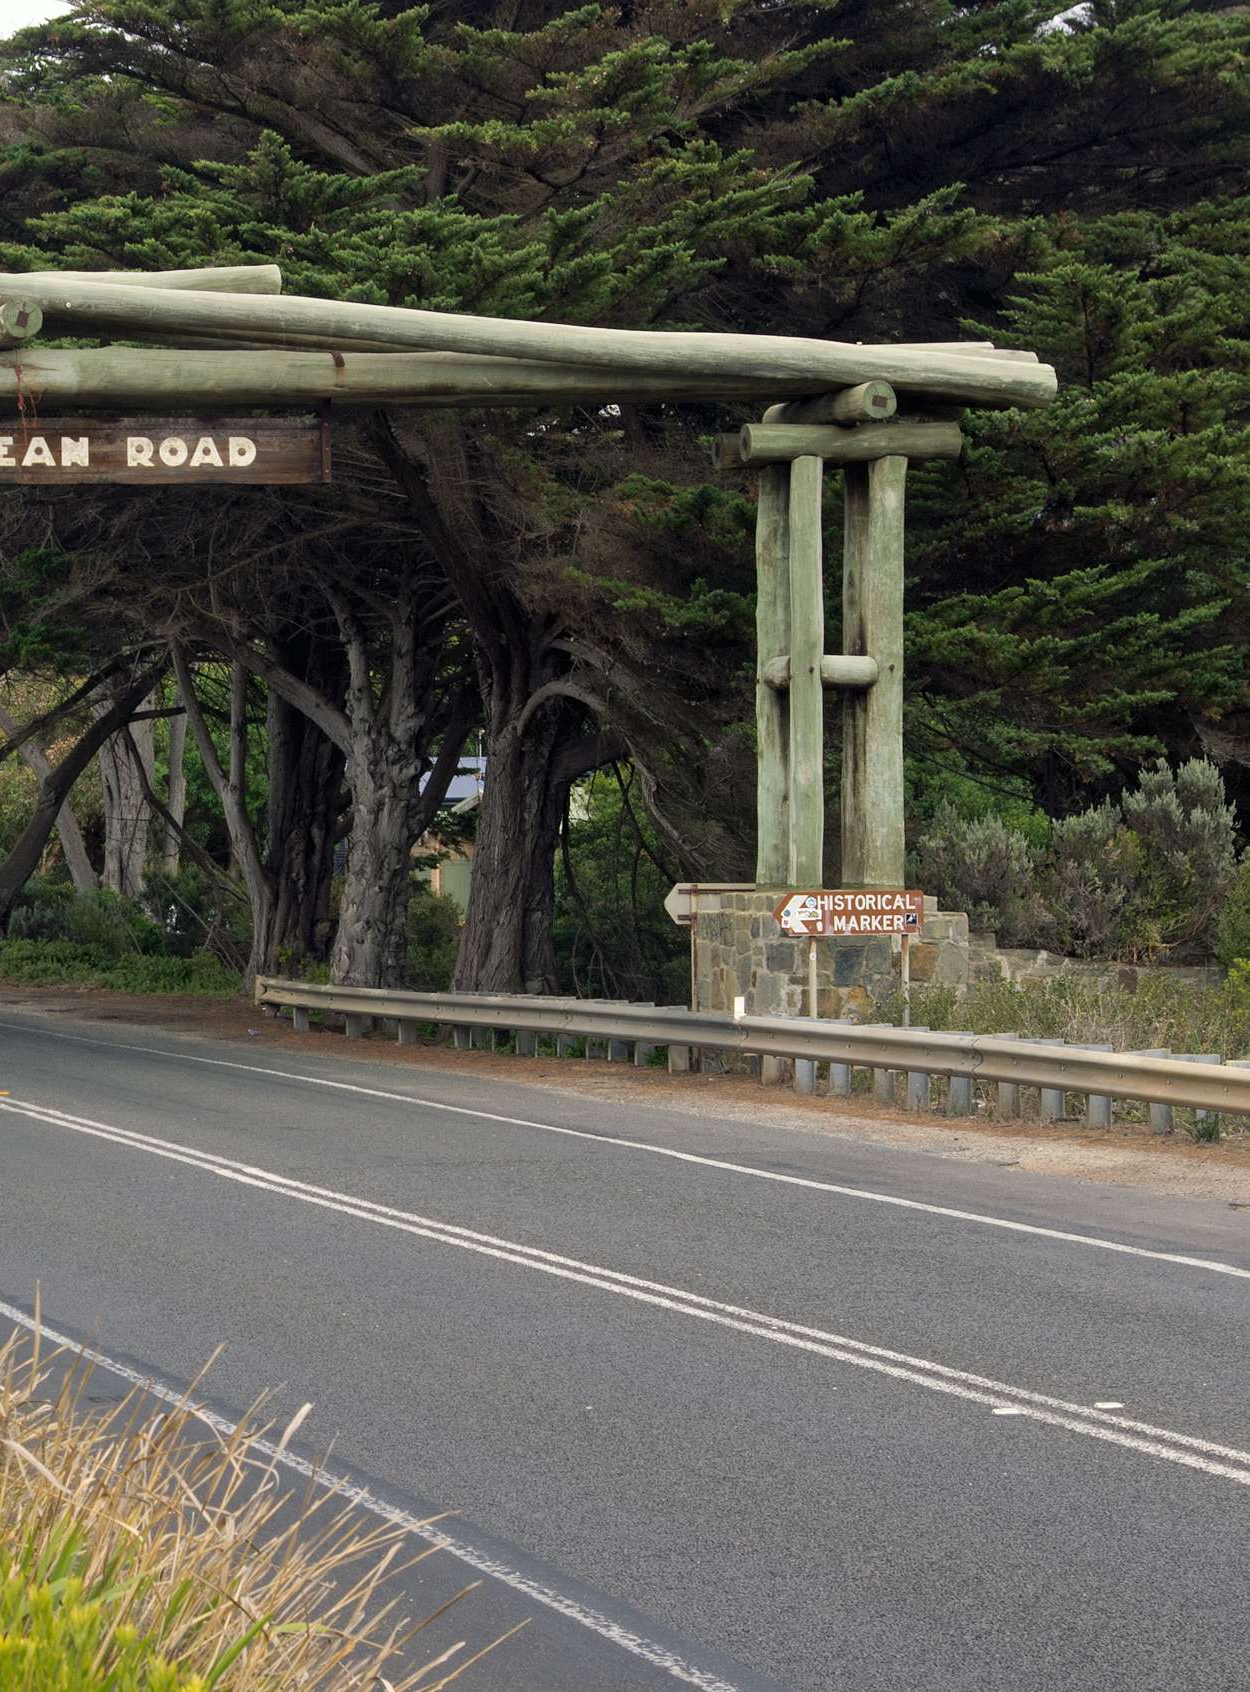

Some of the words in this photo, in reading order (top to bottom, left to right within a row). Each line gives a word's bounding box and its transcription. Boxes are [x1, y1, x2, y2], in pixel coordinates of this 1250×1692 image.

[126, 436, 257, 467] ROAD
[817, 894, 916, 911] HISTORICAL
[833, 915, 904, 931] MARKER
